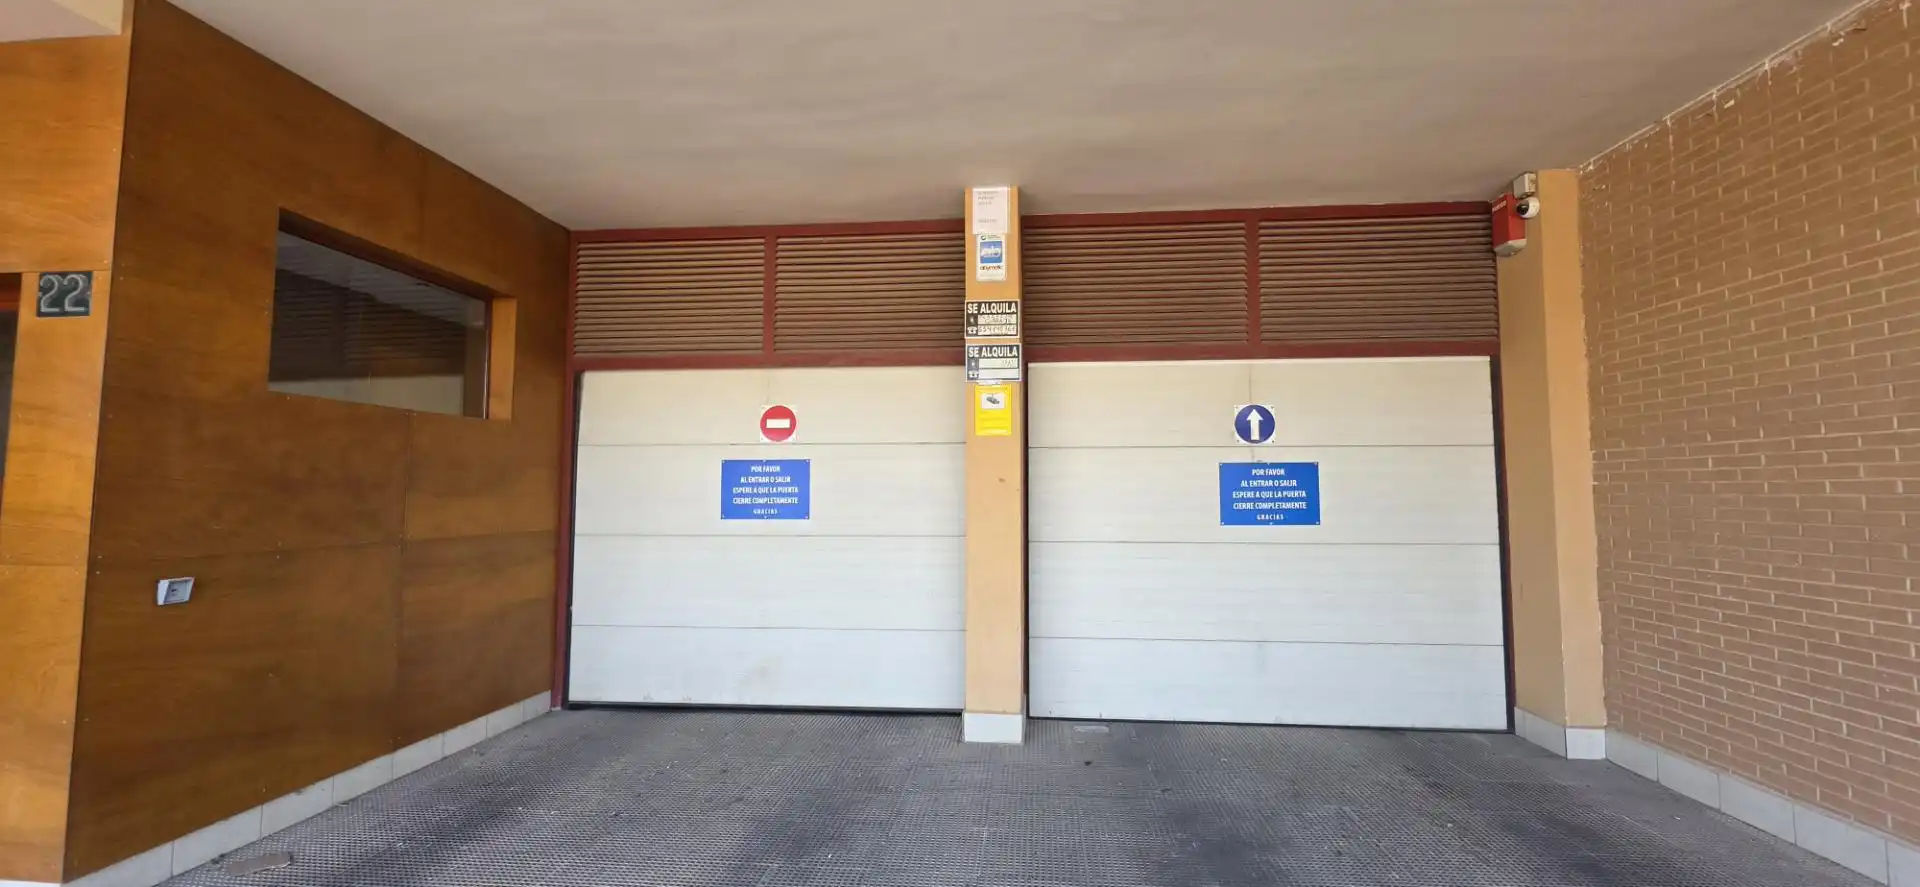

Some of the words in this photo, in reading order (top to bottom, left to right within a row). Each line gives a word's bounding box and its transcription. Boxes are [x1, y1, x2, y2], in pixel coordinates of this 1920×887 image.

[40, 274, 86, 312] 22
[967, 302, 978, 314] SE
[980, 302, 1017, 314] ALQUILA
[968, 346, 979, 358] SE
[981, 346, 1018, 357] ALQUILA
[732, 486, 752, 494] ESPERE
[758, 486, 769, 494] QUE
[1261, 491, 1273, 499] QUE
[1283, 490, 1307, 498] PUERTA
